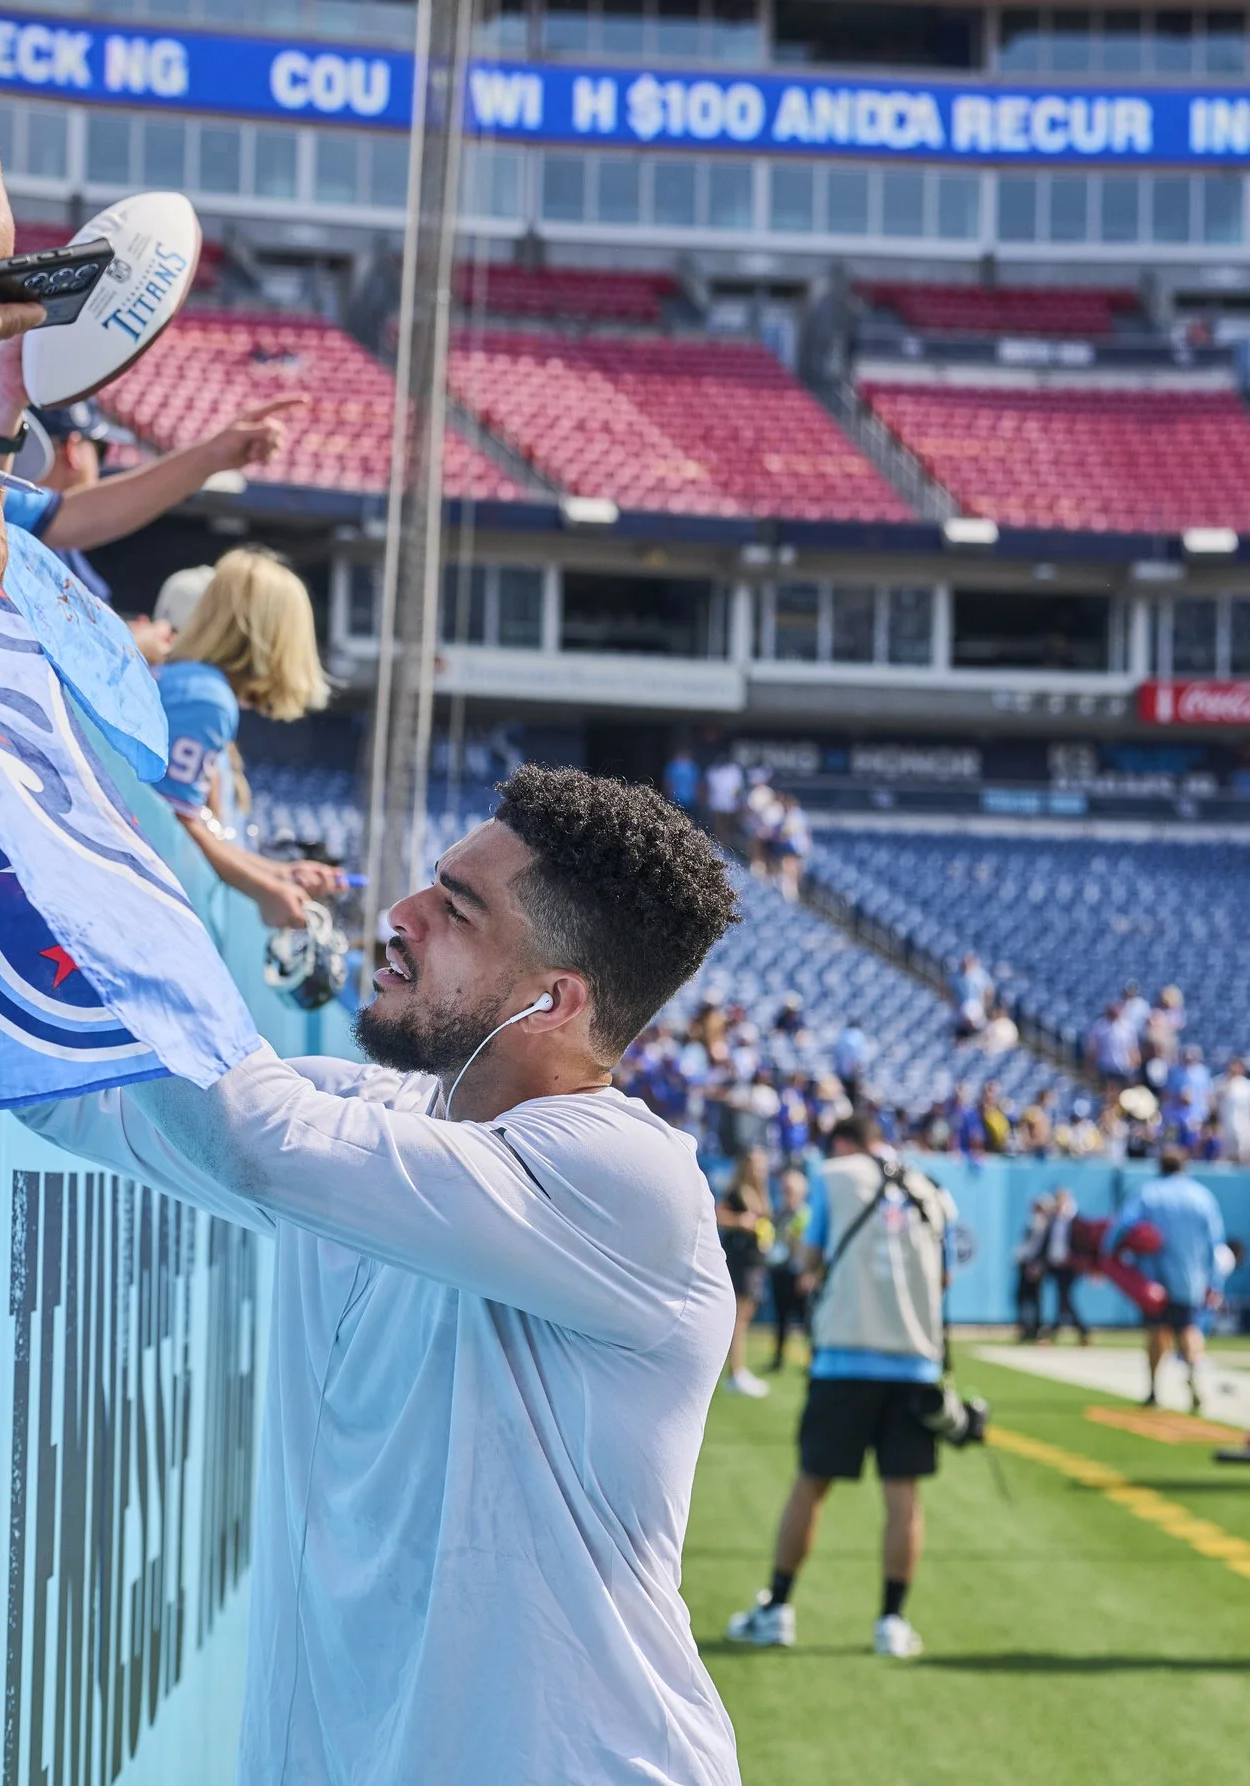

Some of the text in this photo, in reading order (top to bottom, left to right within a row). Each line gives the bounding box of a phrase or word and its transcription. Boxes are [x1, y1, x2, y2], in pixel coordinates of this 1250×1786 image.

[270, 50, 391, 117] COU
[628, 75, 764, 140] $100
[952, 93, 1154, 154] RECUR
[102, 241, 187, 344] TITANS
